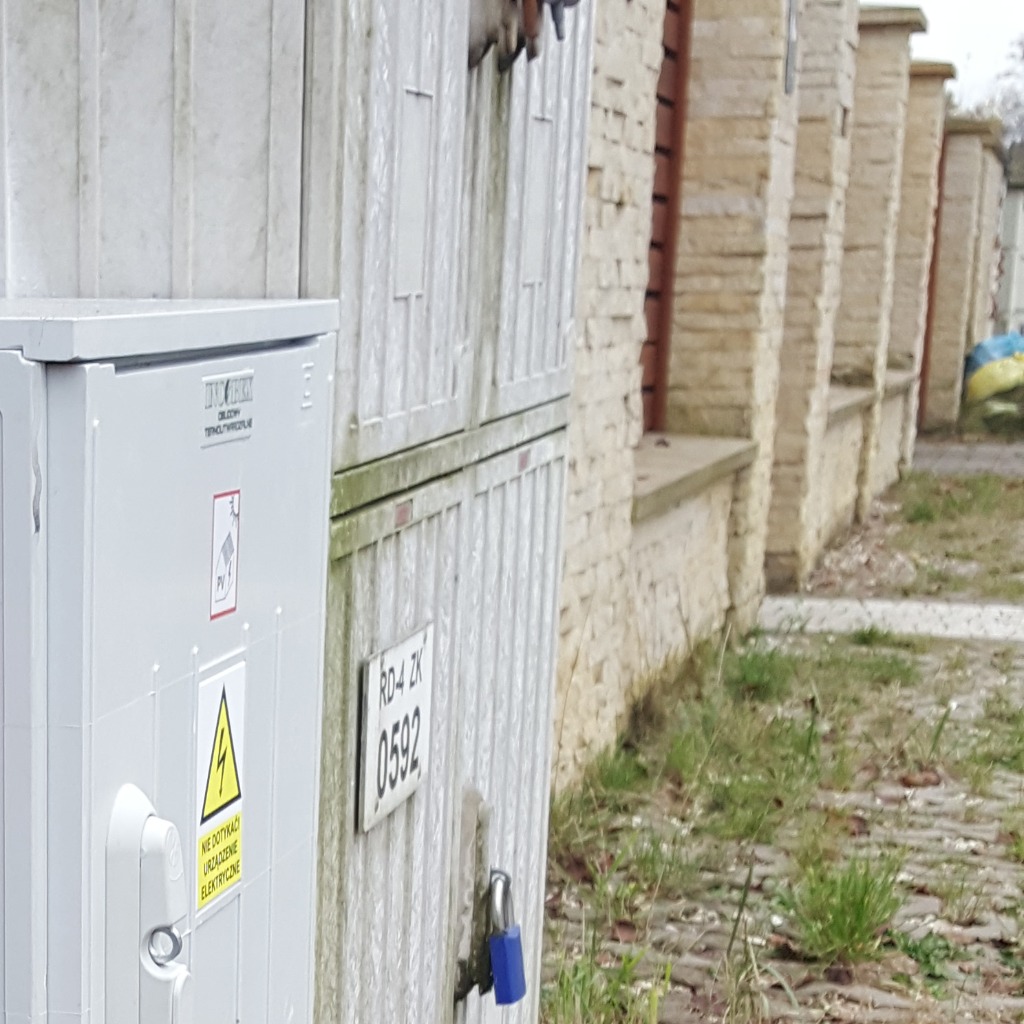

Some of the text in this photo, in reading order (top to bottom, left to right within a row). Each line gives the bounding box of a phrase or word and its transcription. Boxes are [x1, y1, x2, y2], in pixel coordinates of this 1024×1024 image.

[217, 574, 226, 591] PV
[409, 648, 423, 691] ZK
[377, 705, 421, 799] 0592
[201, 837, 211, 856] NIE
[203, 840, 238, 876] URZĄDZENIE
[201, 859, 240, 901] ELEKTRYCZNE
